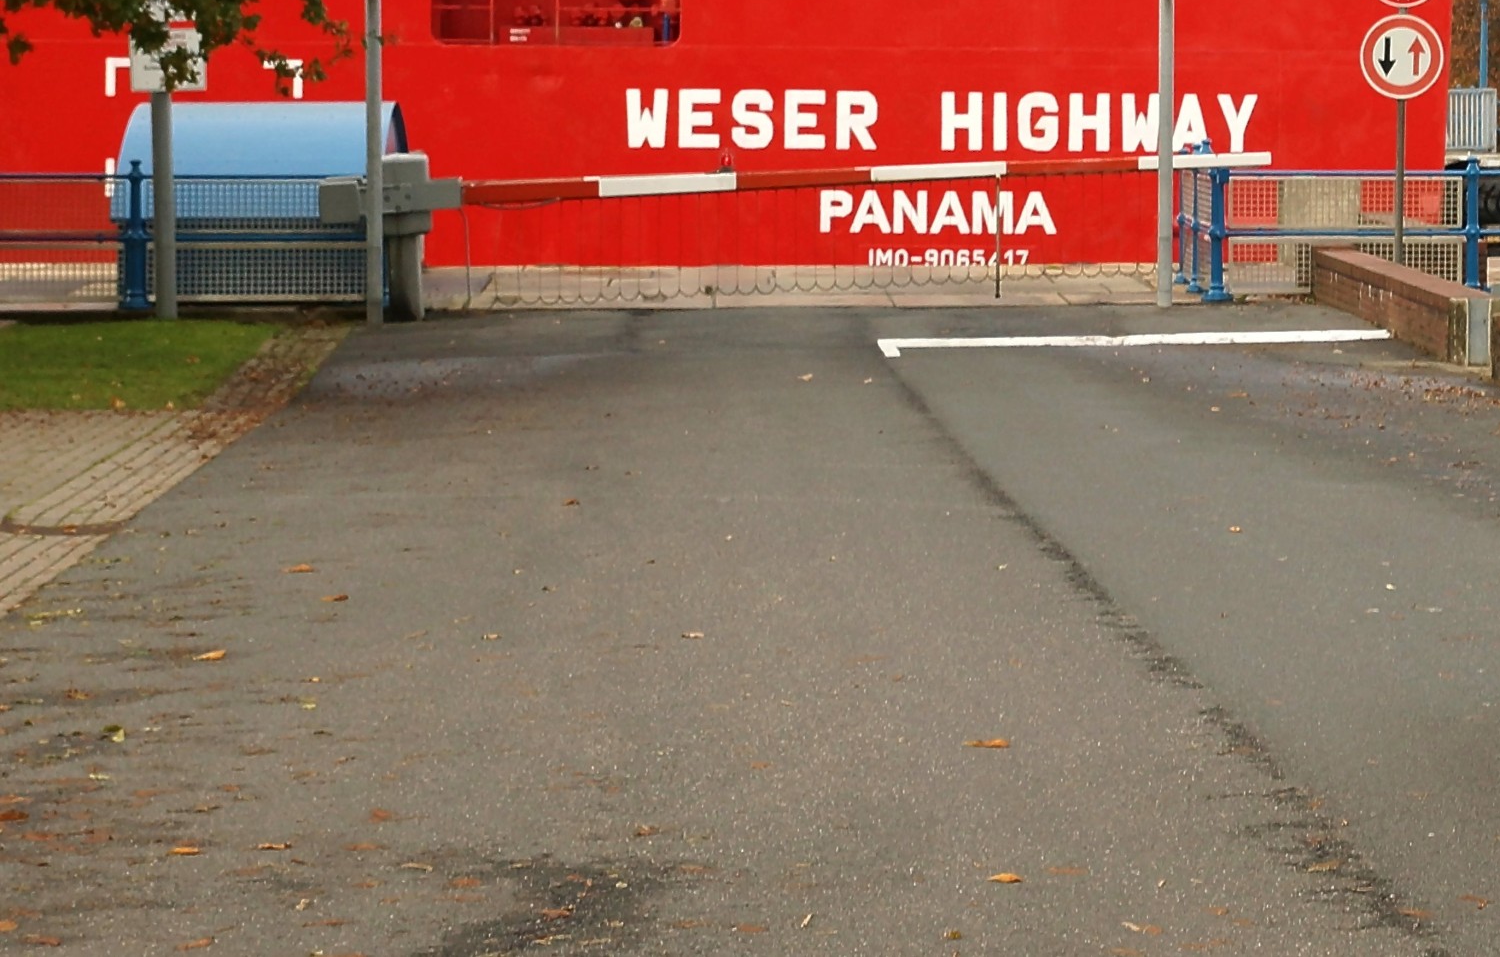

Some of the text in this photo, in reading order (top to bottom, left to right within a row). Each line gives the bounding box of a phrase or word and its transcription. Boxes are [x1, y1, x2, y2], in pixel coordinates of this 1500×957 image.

[625, 88, 1259, 153] WESER HIGHWAY
[819, 189, 1057, 235] PANAMA
